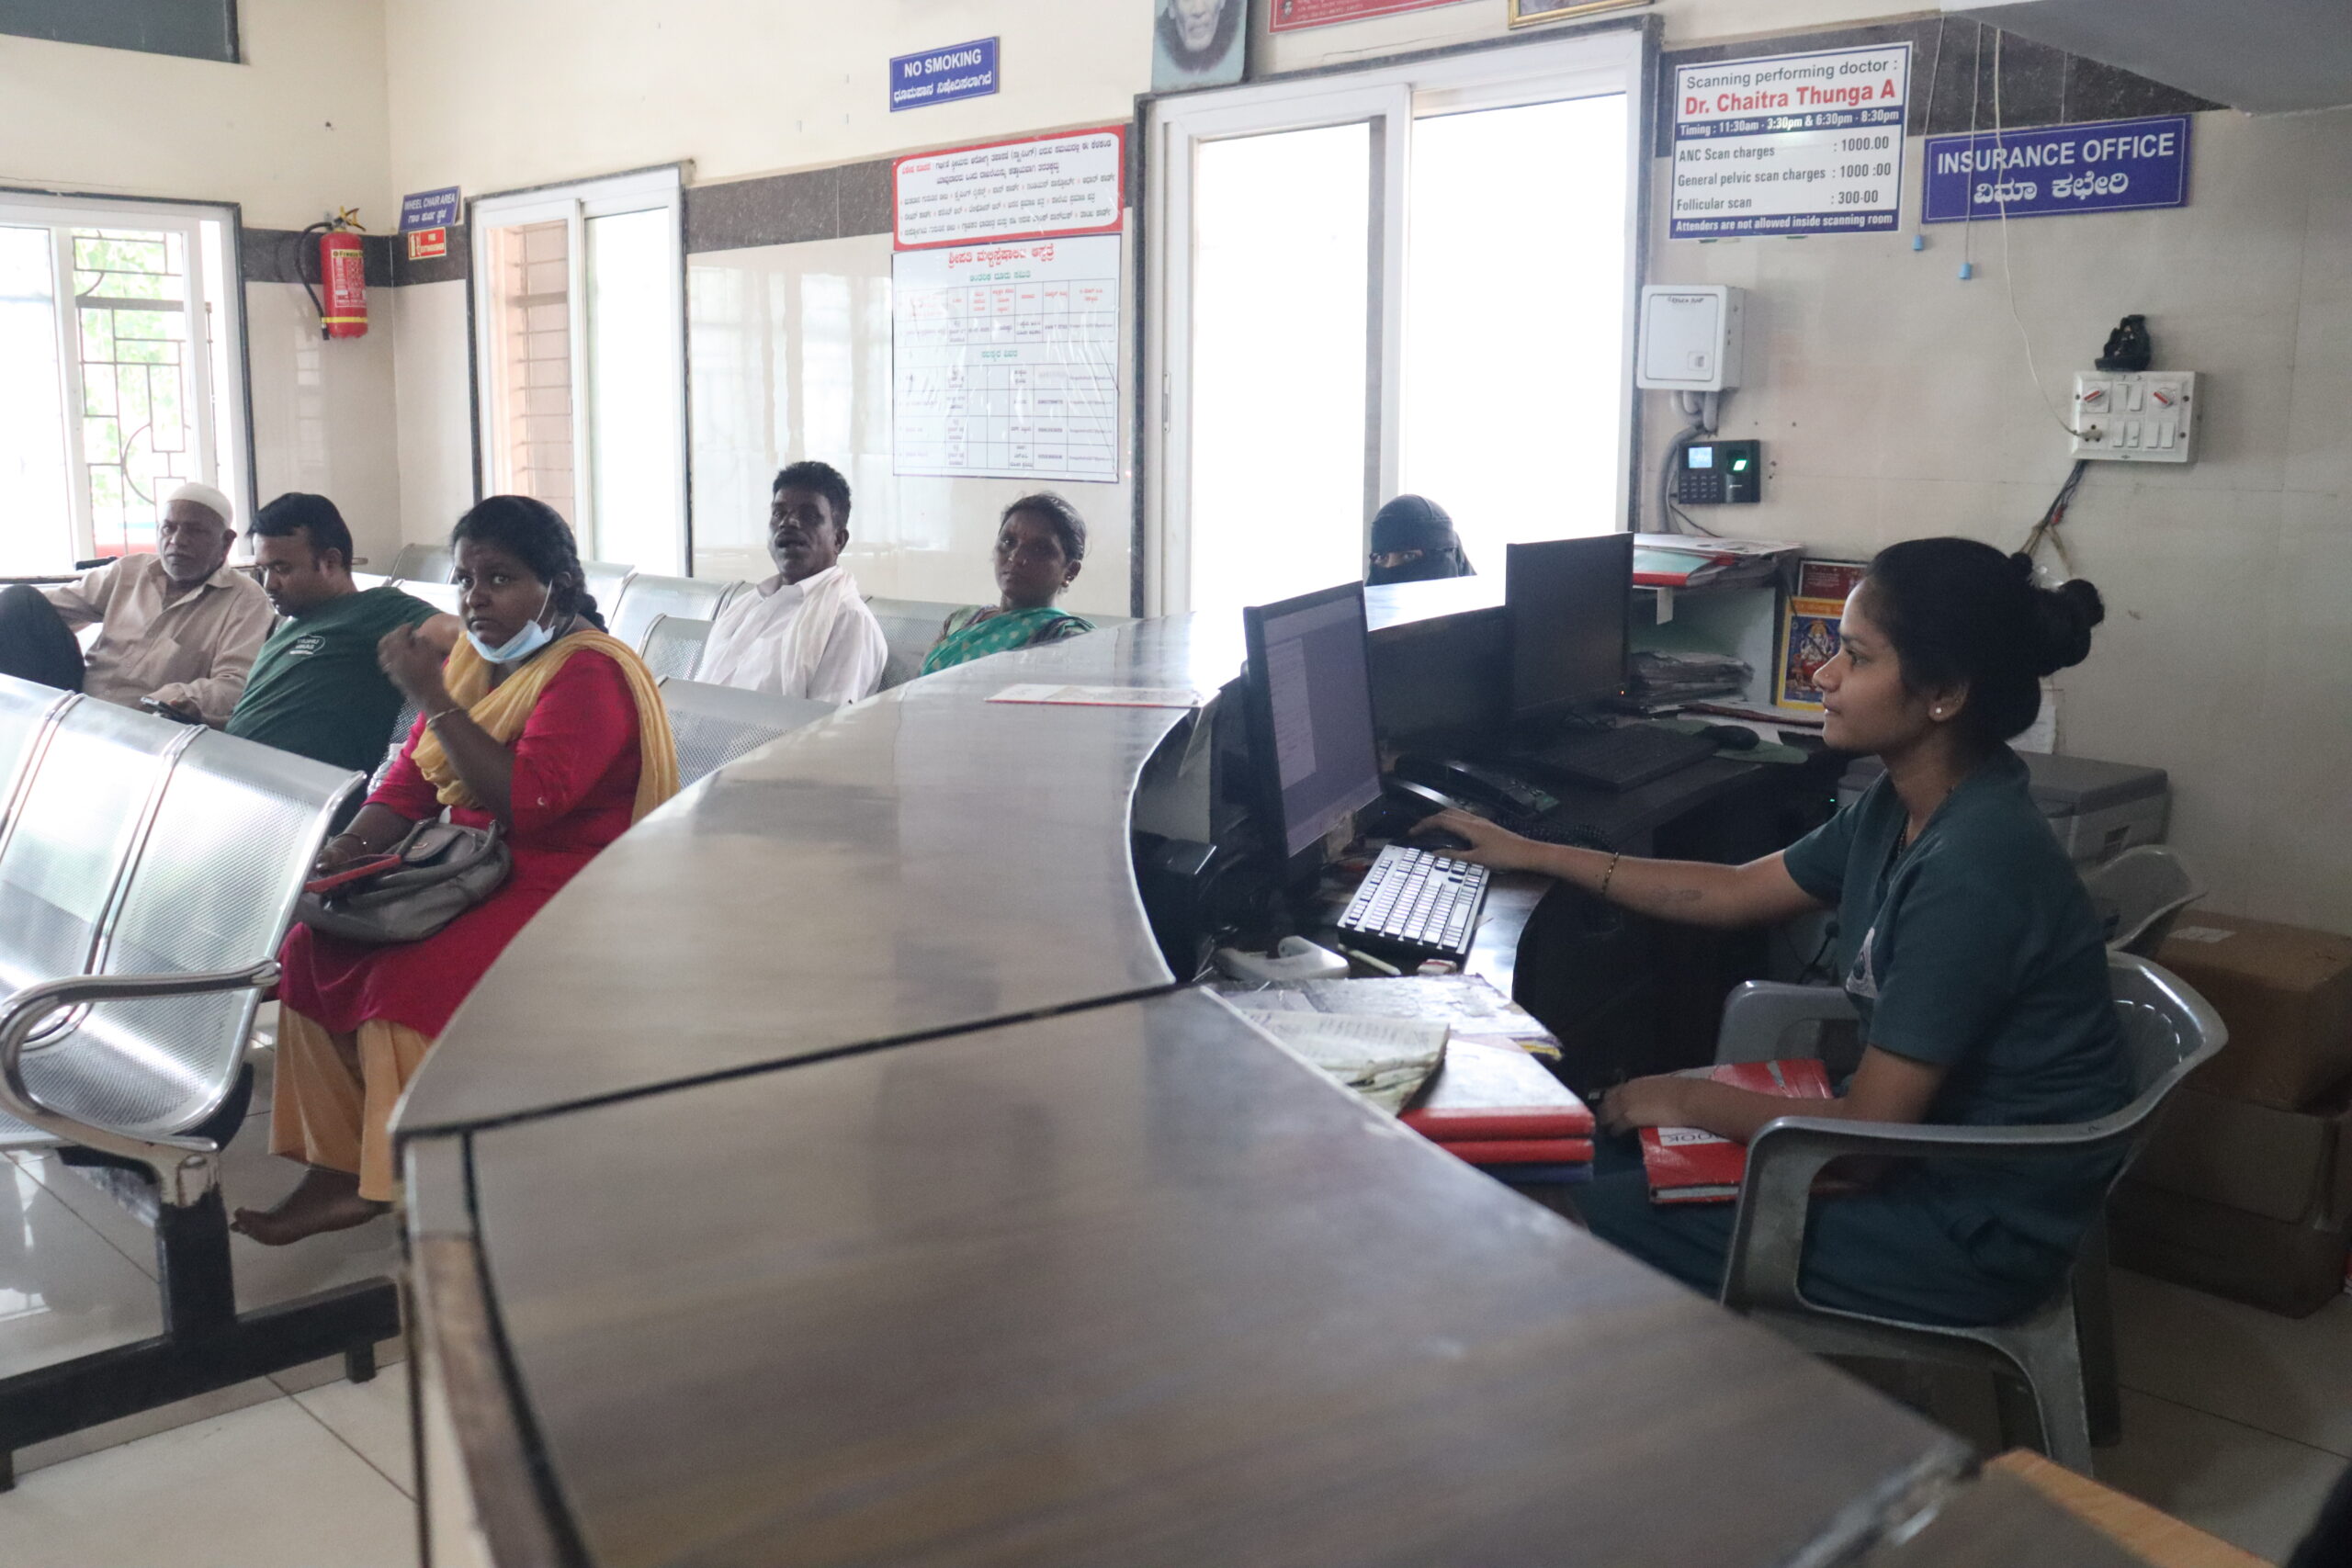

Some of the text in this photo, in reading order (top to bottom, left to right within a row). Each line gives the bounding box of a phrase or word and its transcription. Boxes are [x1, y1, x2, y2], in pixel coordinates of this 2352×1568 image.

[904, 49, 981, 78] NO SMOKING
[1687, 73, 1750, 89] Scanning
[1756, 65, 1834, 87] performing
[1839, 60, 1887, 75] doctor
[1685, 79, 1896, 115] Dr. Chaitra Thunga A
[1680, 124, 1711, 137] Timing
[1719, 119, 1759, 133] 11:30am
[1767, 117, 1803, 131] 3:30pm
[1804, 117, 1814, 127] &
[1815, 113, 1853, 128] 6:30pm
[1861, 110, 1899, 124] 8:30pm
[1679, 149, 1701, 162] ANC
[1705, 147, 1730, 161] Scan
[1733, 145, 1775, 161] charges
[1938, 132, 2175, 175] INSURANCE OFFICE
[1678, 172, 1717, 186] General
[1720, 170, 1751, 186] pelvic
[1755, 171, 1779, 182] scan
[1782, 167, 1826, 183] charges
[1973, 171, 2129, 204] ವಿಮಾ ಕಛೇರಿ
[423, 195, 440, 208] CHAIR
[440, 192, 456, 205] AREA
[1677, 197, 1724, 211] Follicular
[1728, 198, 1752, 209] scan
[1676, 214, 1893, 231] Attenders are not allowed inside scanning room
